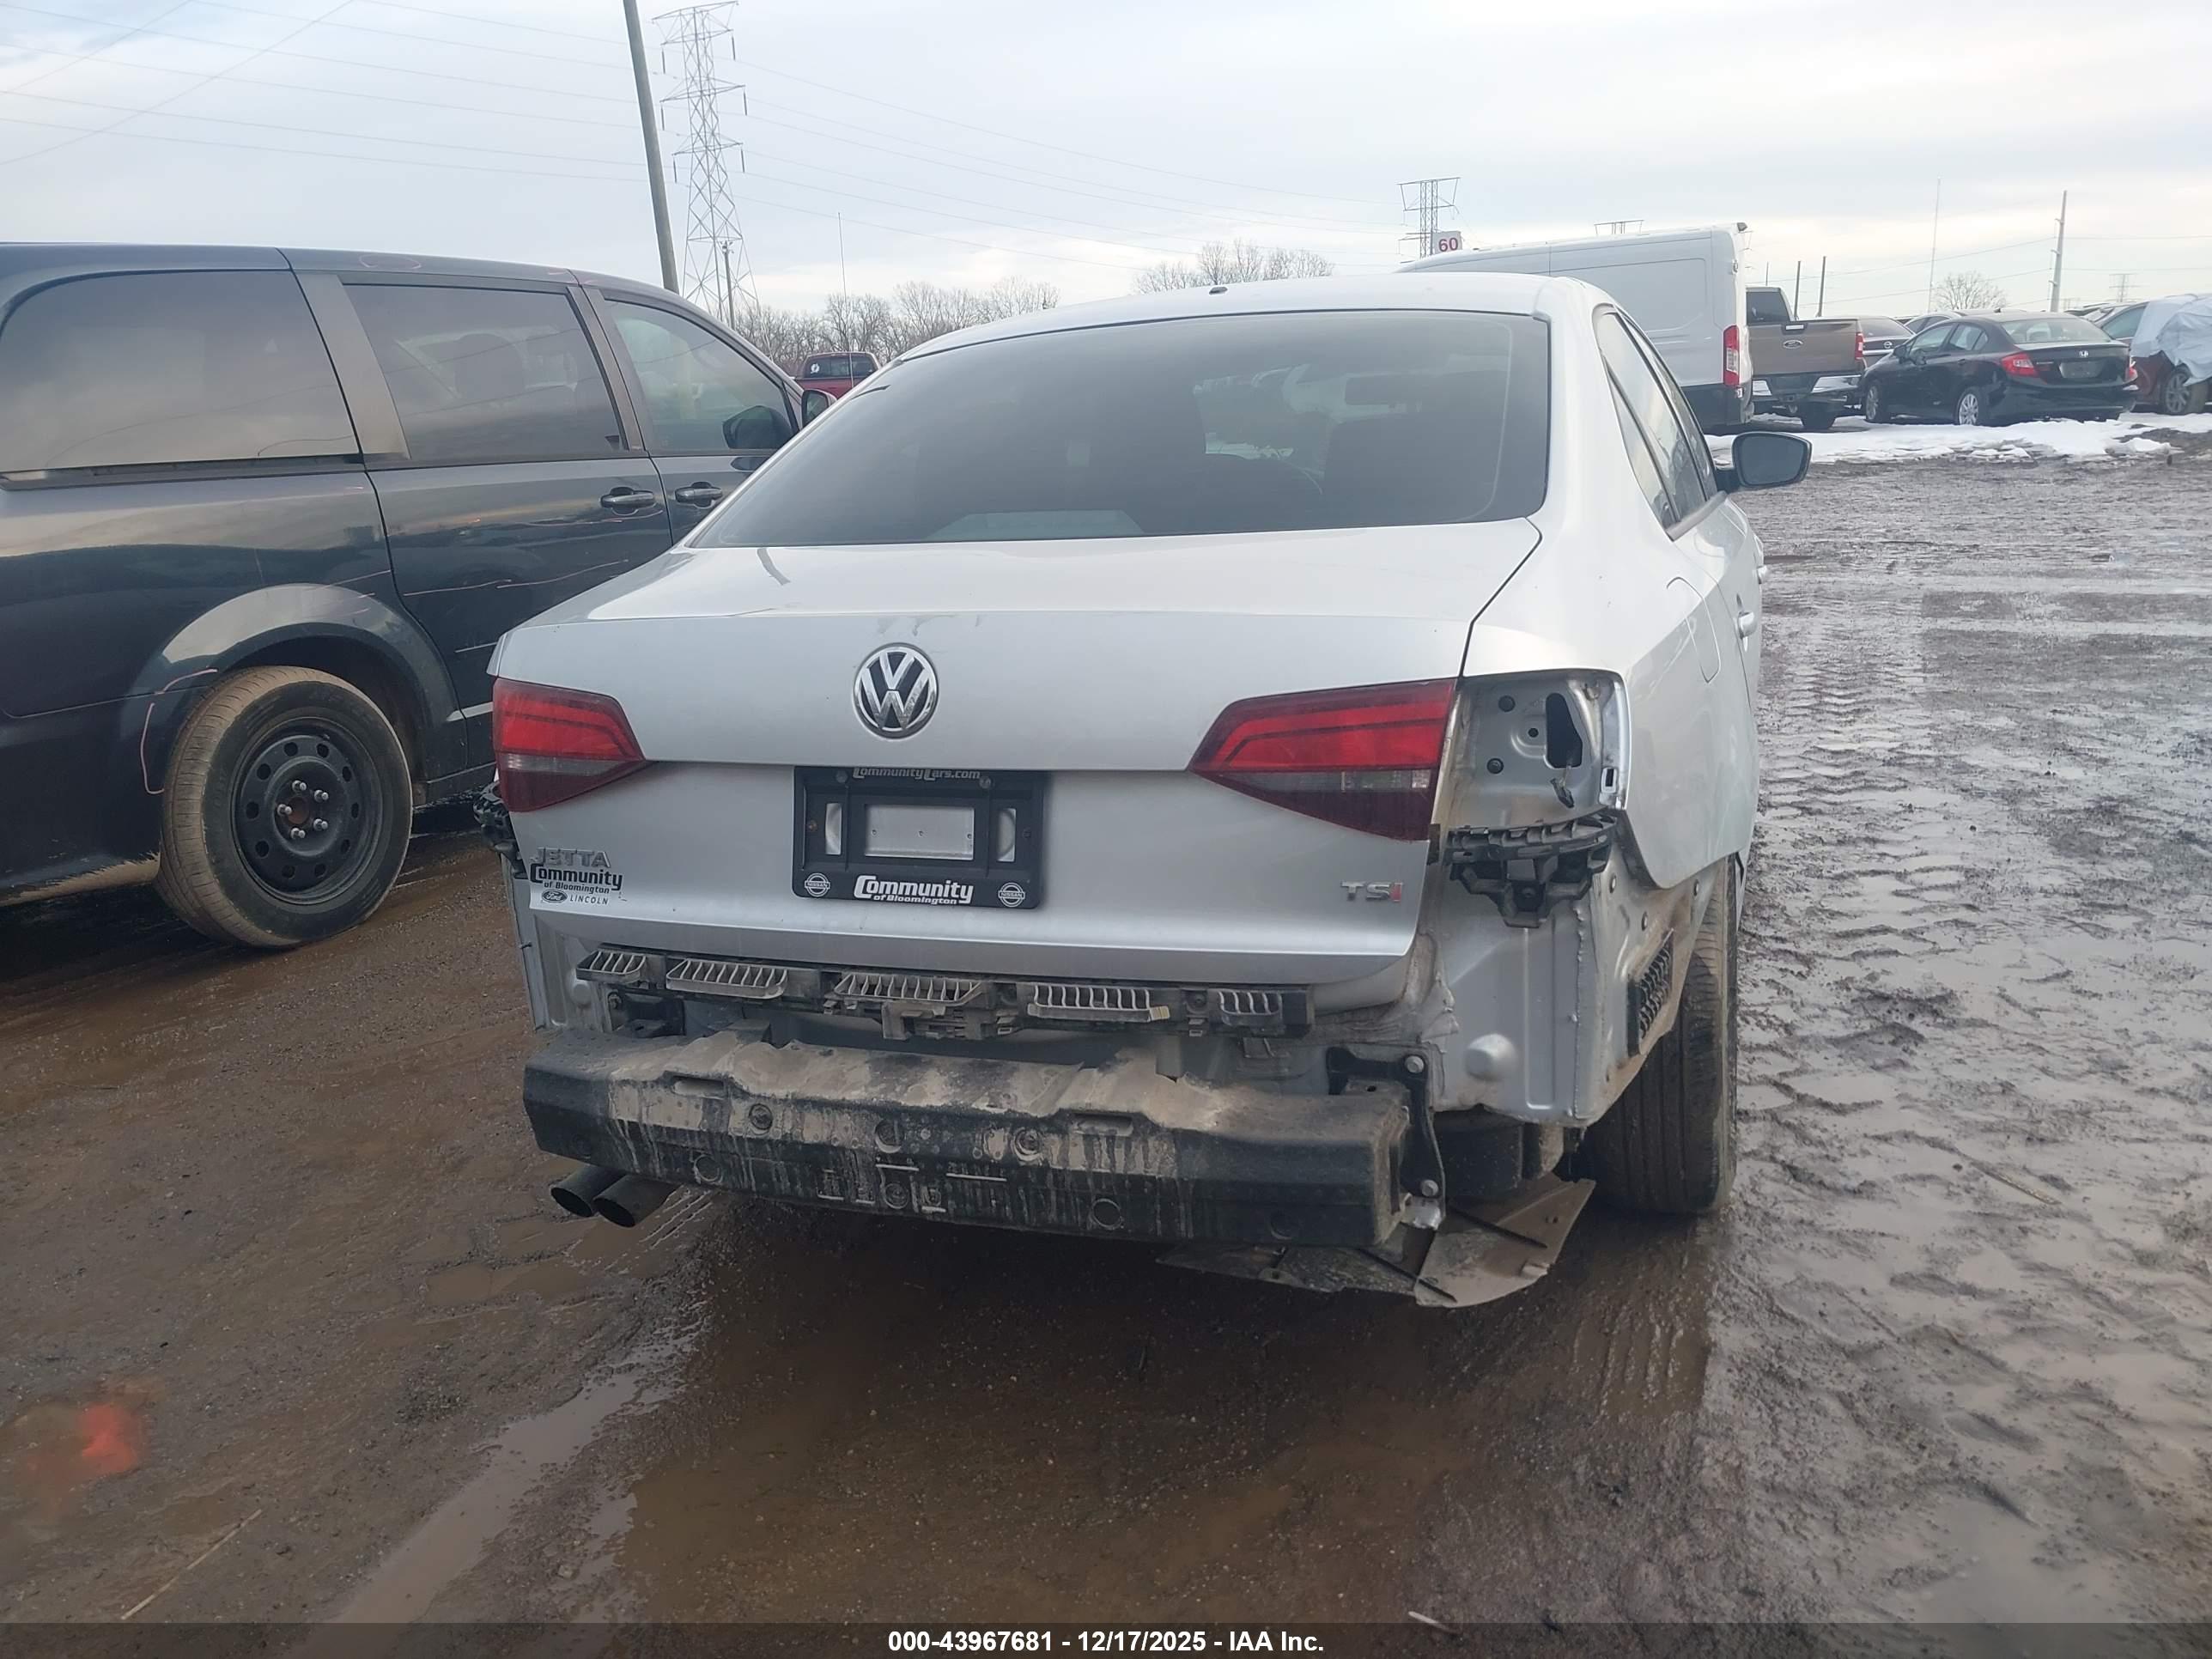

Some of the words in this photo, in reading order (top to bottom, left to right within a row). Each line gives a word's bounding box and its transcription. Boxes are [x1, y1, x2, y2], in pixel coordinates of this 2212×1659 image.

[1438, 237, 1459, 252] 60
[530, 847, 611, 868] JETTA
[530, 863, 623, 891] Community
[556, 881, 610, 895] Bloomington
[854, 875, 974, 904] Community
[569, 894, 609, 905] LINCOLN
[886, 894, 957, 905] Bloomington
